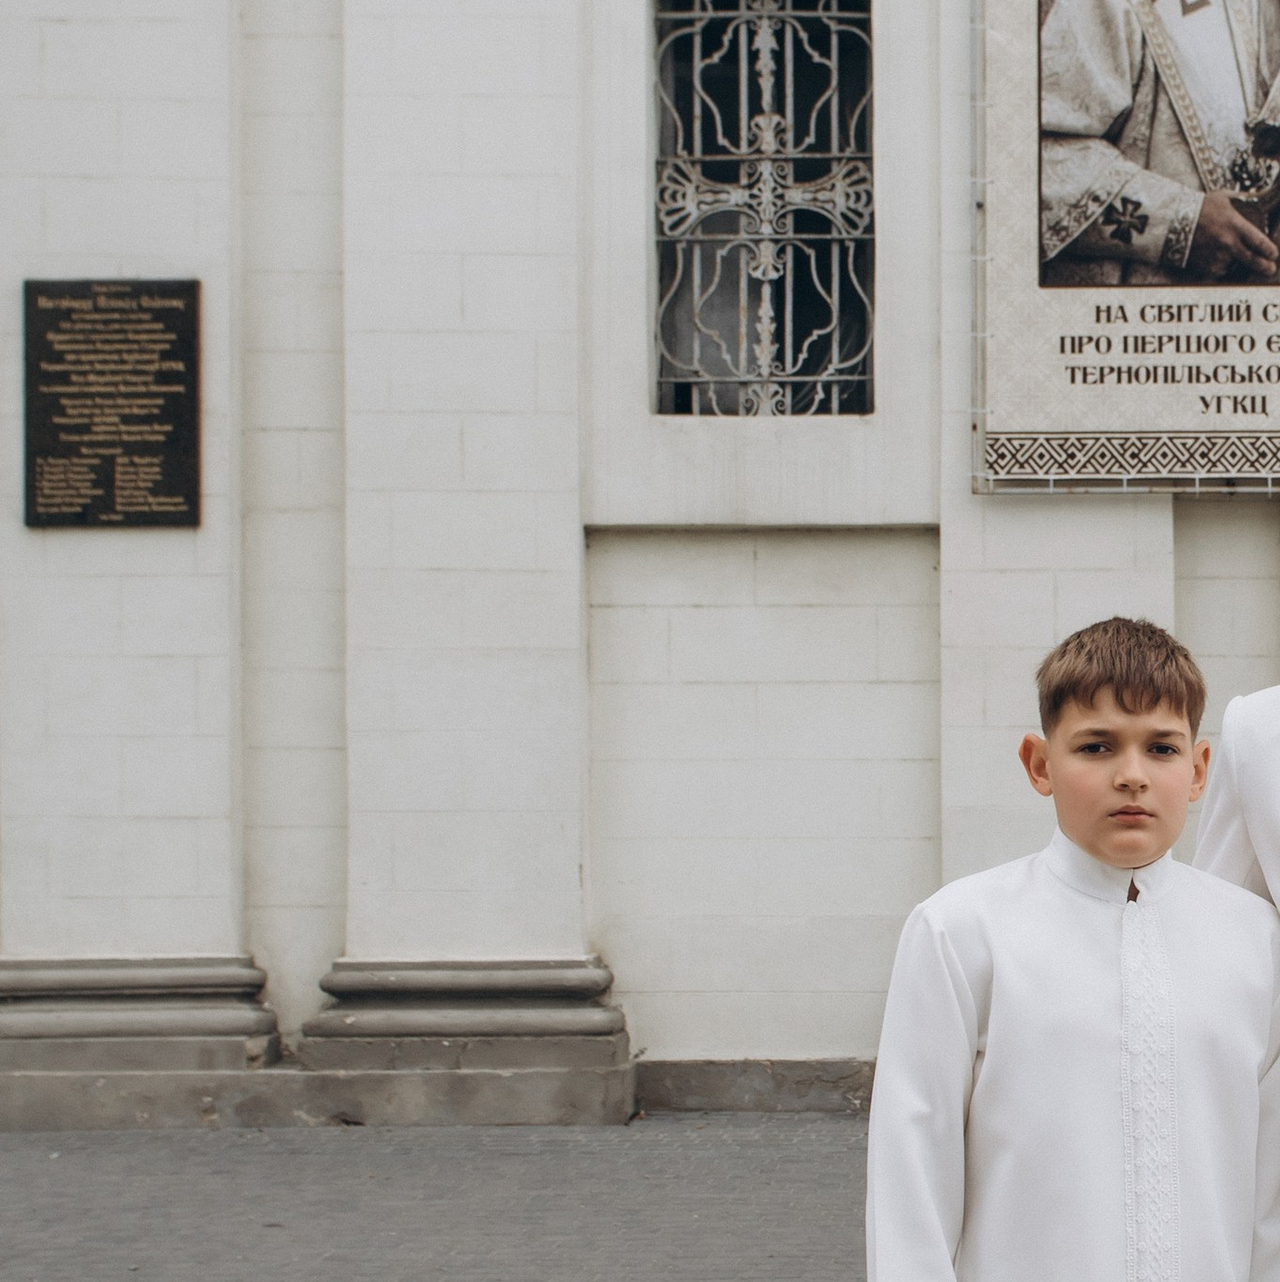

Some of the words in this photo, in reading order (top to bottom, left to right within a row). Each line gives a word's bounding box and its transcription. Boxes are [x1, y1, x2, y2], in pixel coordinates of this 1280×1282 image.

[1094, 303, 1129, 325] НА
[1139, 299, 1252, 325] СВІТЛИЙ
[1059, 334, 1112, 356] ПРО
[1122, 334, 1256, 355] ПЕРШОГО
[1198, 395, 1270, 418] УГКЦ
